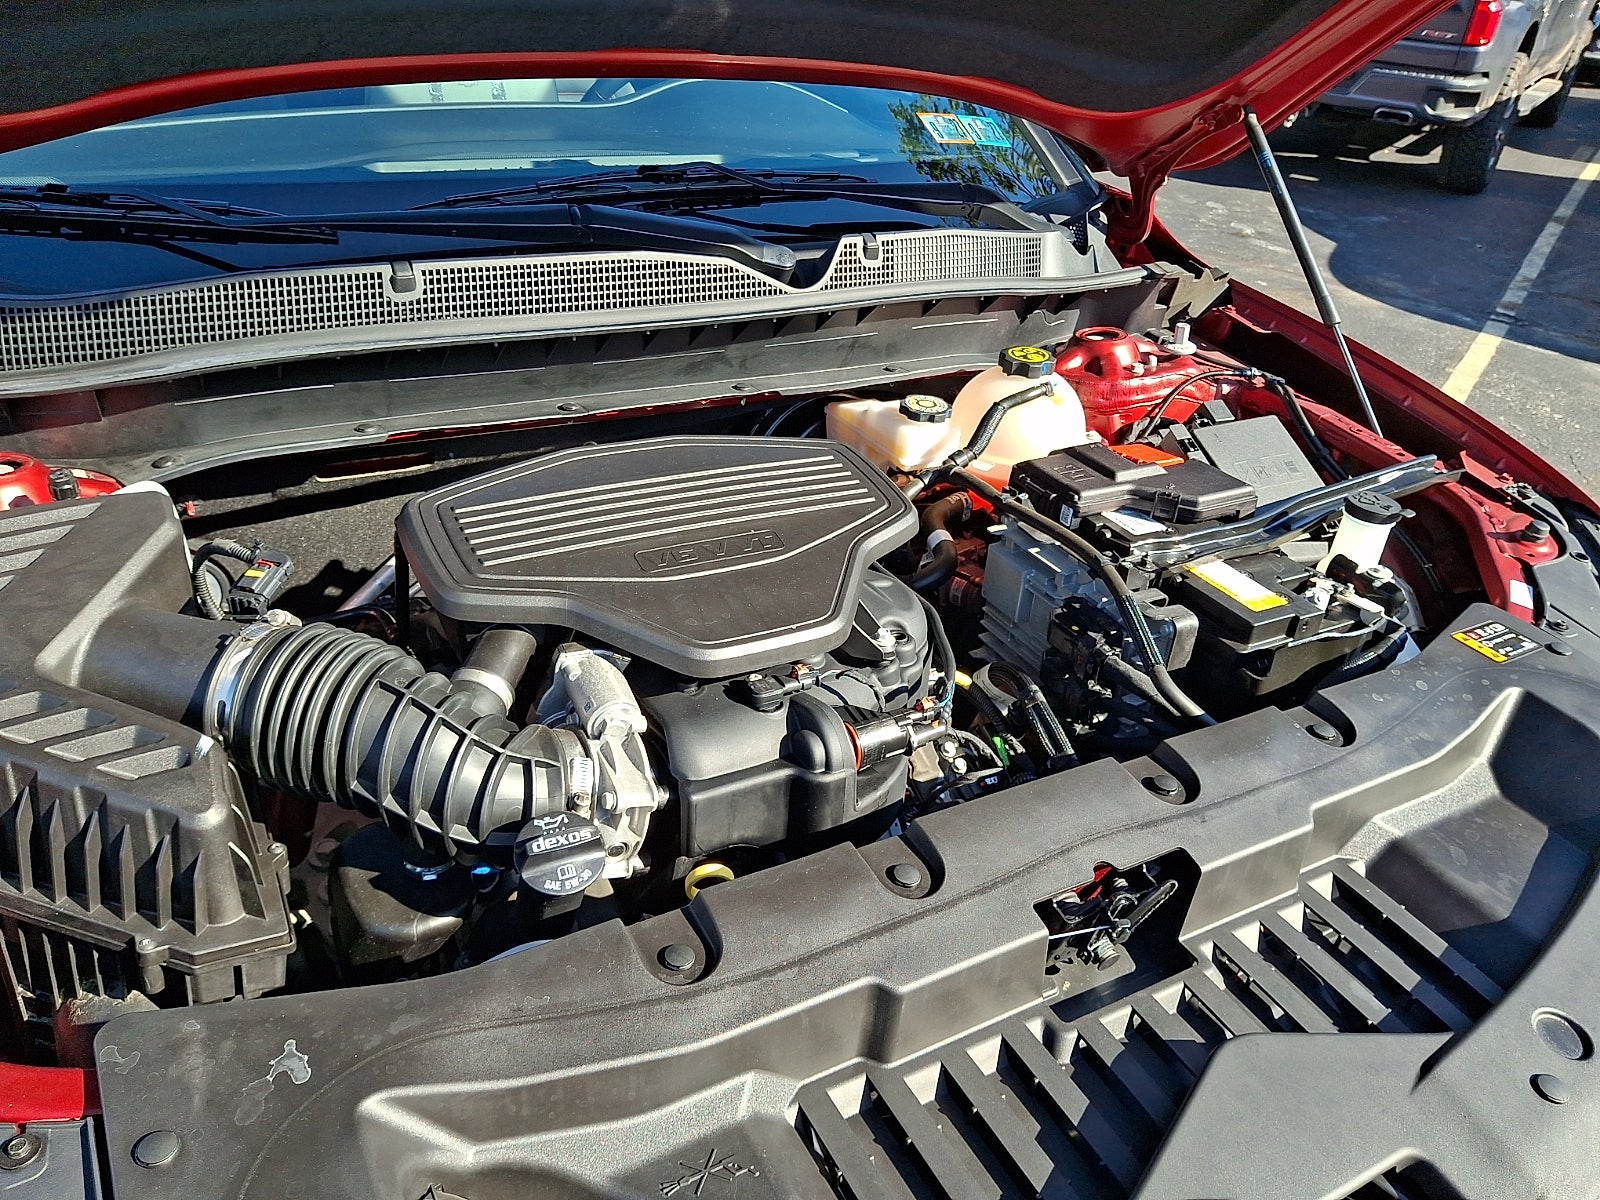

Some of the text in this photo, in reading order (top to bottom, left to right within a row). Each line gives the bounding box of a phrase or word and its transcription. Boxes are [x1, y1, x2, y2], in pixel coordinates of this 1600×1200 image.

[642, 548, 699, 567] V6
[532, 830, 592, 853] dexos
[544, 868, 592, 890] SAE 5W-30
